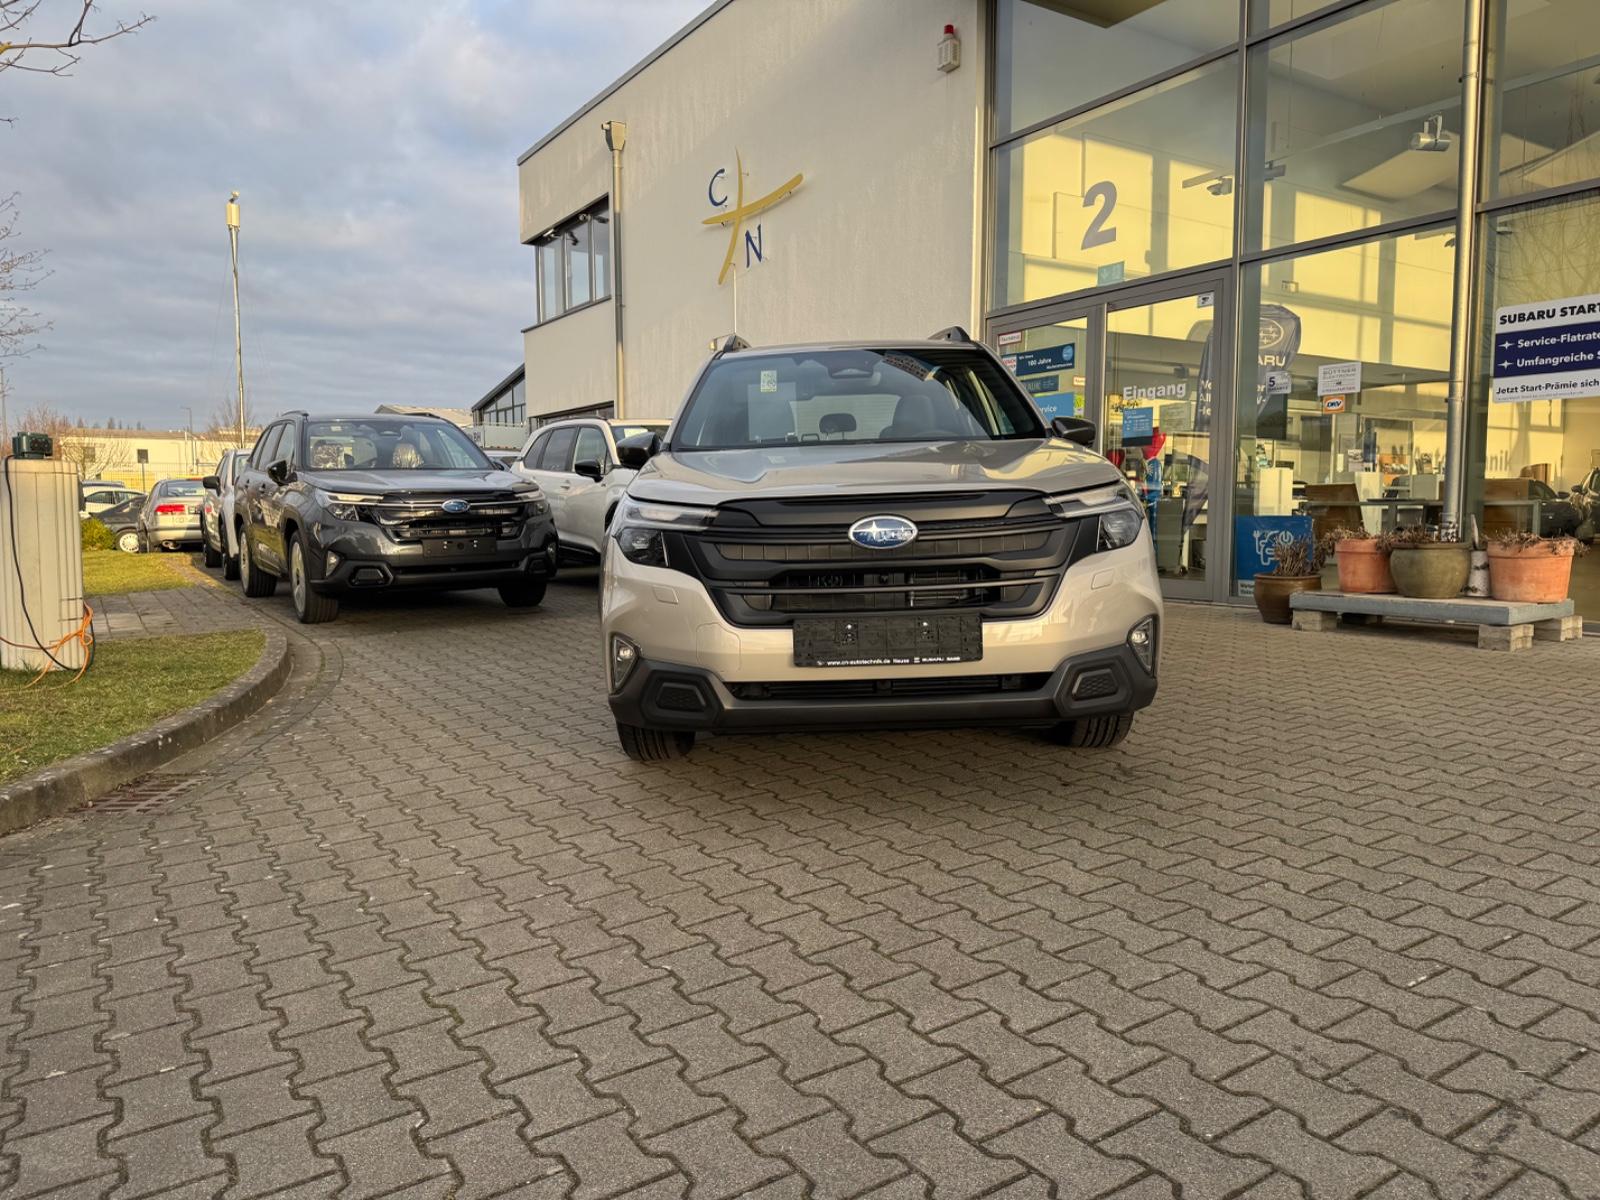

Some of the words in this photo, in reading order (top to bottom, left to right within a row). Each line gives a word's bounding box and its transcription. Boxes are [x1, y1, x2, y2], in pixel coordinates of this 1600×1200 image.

[709, 168, 728, 207] C
[1081, 180, 1117, 251] 2
[745, 223, 762, 268] N
[1500, 308, 1556, 325] SUBARU
[1516, 352, 1594, 367] Umfangreiche
[1268, 376, 1276, 388] 5
[1520, 380, 1578, 393] Start-Prämie
[1123, 383, 1187, 400] Eingang
